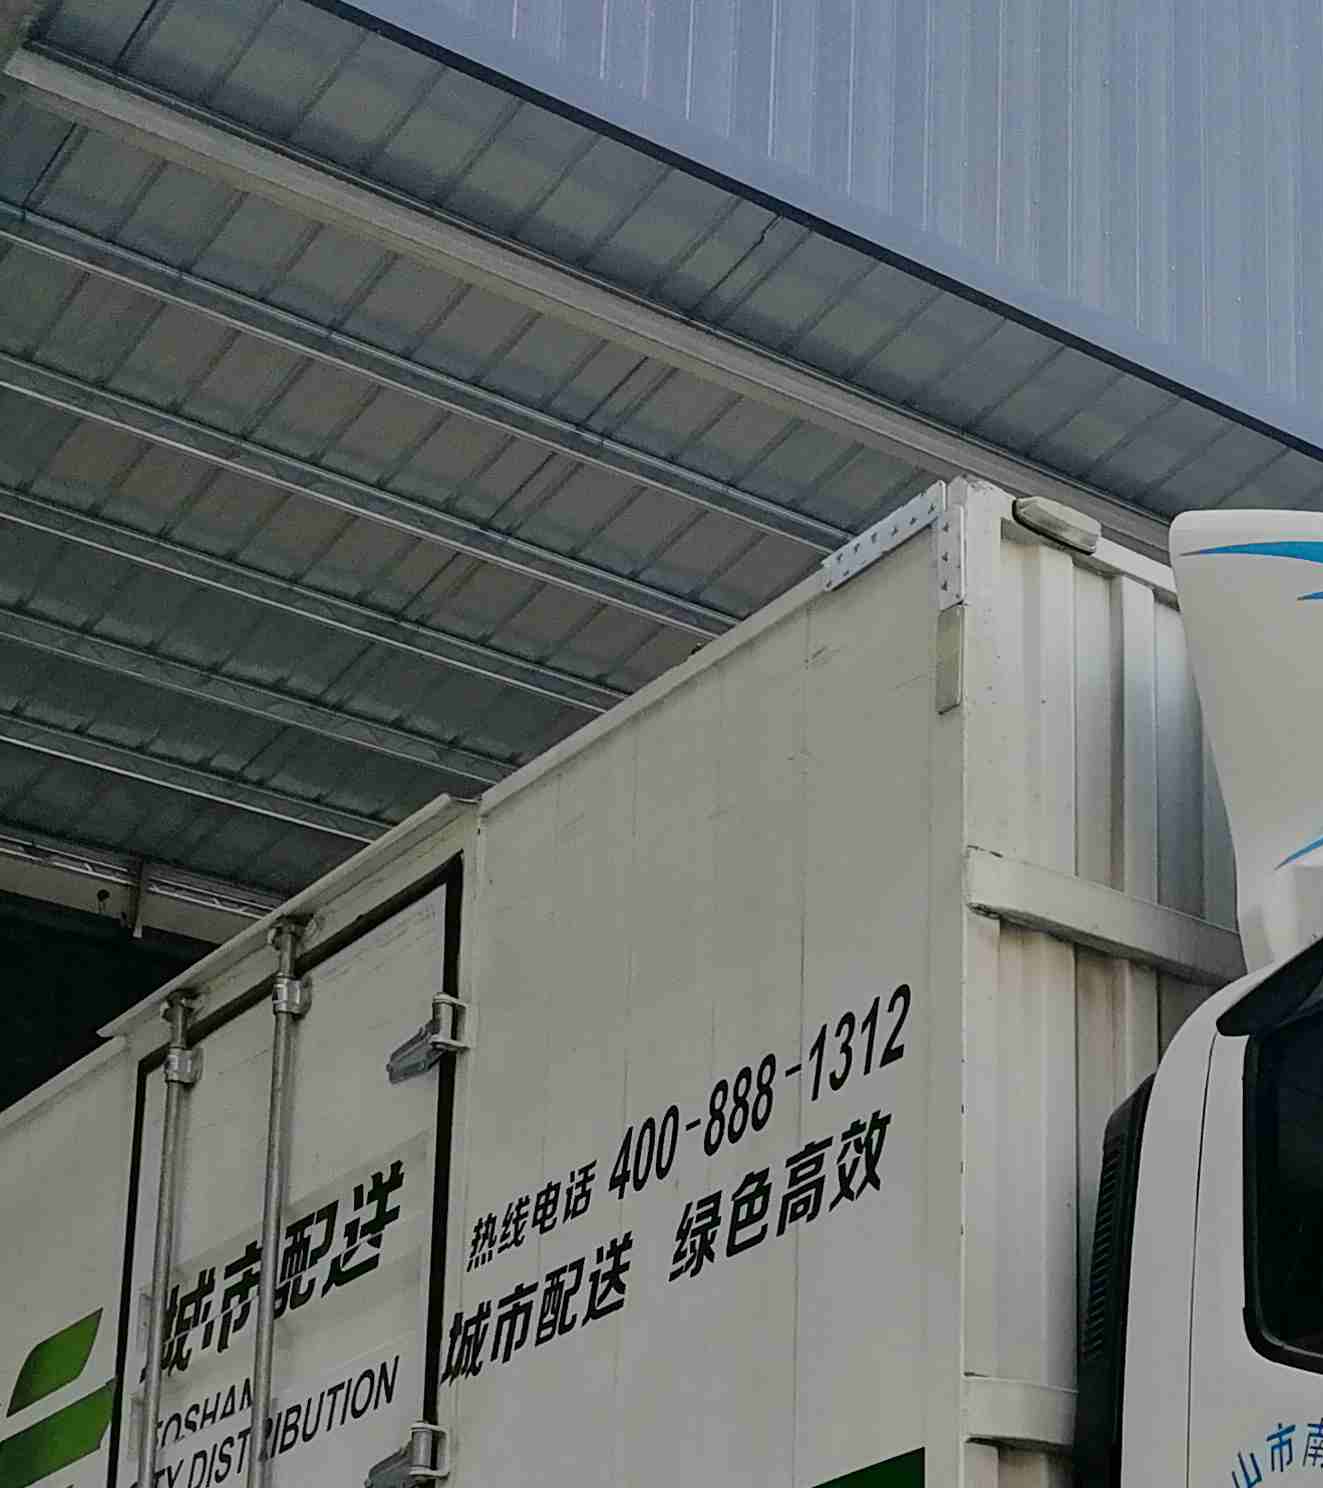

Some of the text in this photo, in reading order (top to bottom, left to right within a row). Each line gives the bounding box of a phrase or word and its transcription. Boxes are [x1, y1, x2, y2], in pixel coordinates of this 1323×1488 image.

[440, 1109, 892, 1385] 城市配送 绿色高效
[467, 984, 911, 1272] 热线电话 400-888-1312
